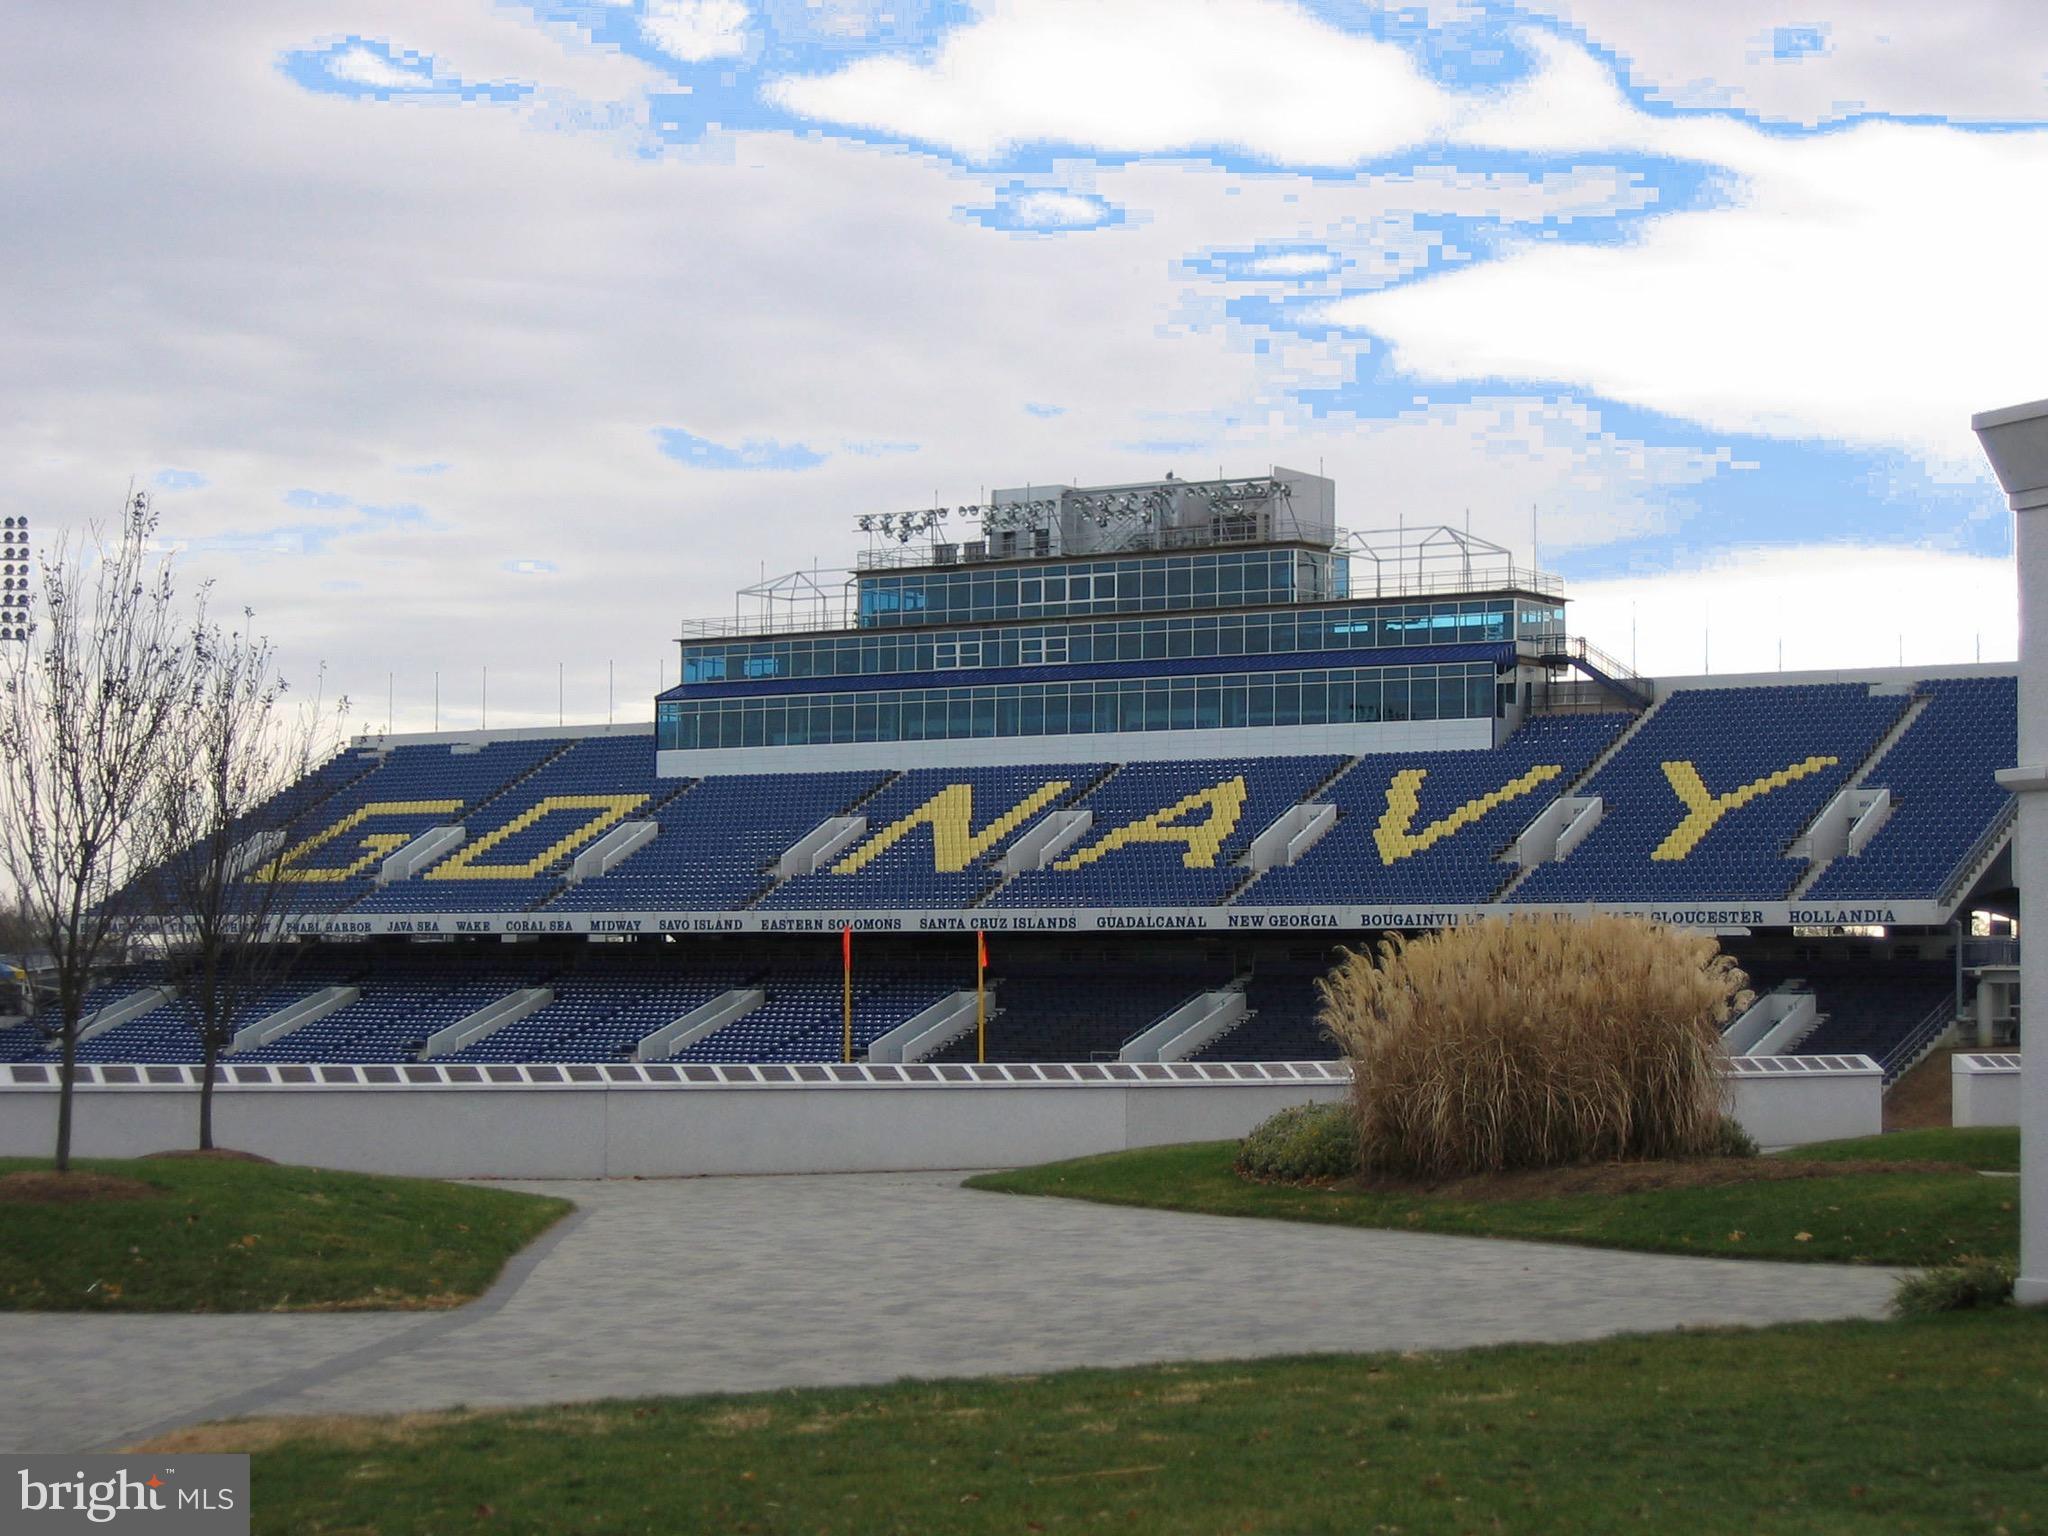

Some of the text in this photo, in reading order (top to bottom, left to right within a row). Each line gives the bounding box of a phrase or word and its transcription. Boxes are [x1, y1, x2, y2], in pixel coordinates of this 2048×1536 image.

[243, 756, 1838, 884] GO NAVY
[1097, 916, 1207, 928] GUADALCANAL
[1228, 915, 1338, 927] NEW GEORGIA
[1651, 911, 1763, 924] GLOUCESTER
[1789, 910, 1896, 923] HOLLANDIA
[386, 921, 439, 932] JAVA SEA
[456, 921, 490, 932] WAKE
[506, 920, 573, 931] CORAL SEA
[590, 920, 642, 931] MIDWAY
[659, 919, 743, 930] SAVO ISLAND
[761, 918, 901, 930] EASTERN SOLOMONS
[919, 917, 1077, 929] SANTA CRUZ ISLANDS
